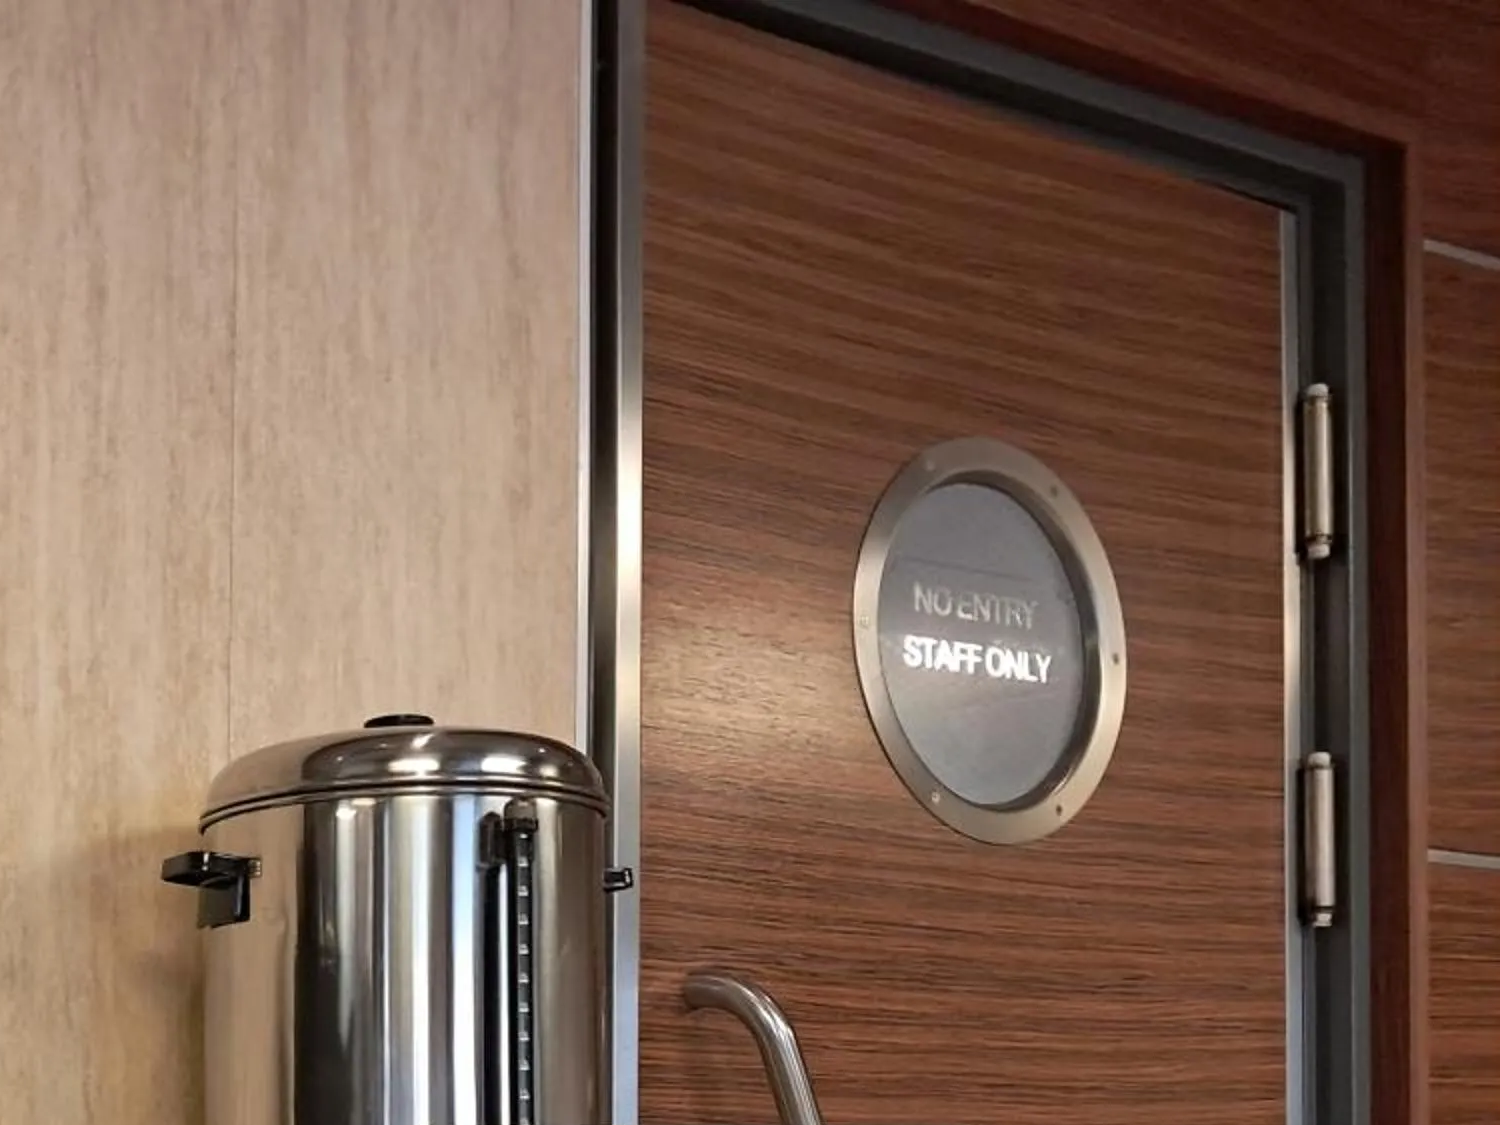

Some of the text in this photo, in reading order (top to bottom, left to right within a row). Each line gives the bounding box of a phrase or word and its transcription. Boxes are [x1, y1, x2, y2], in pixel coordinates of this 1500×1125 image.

[913, 581, 1039, 629] NO ENTRY
[902, 634, 1052, 684] STAFF ONLY
